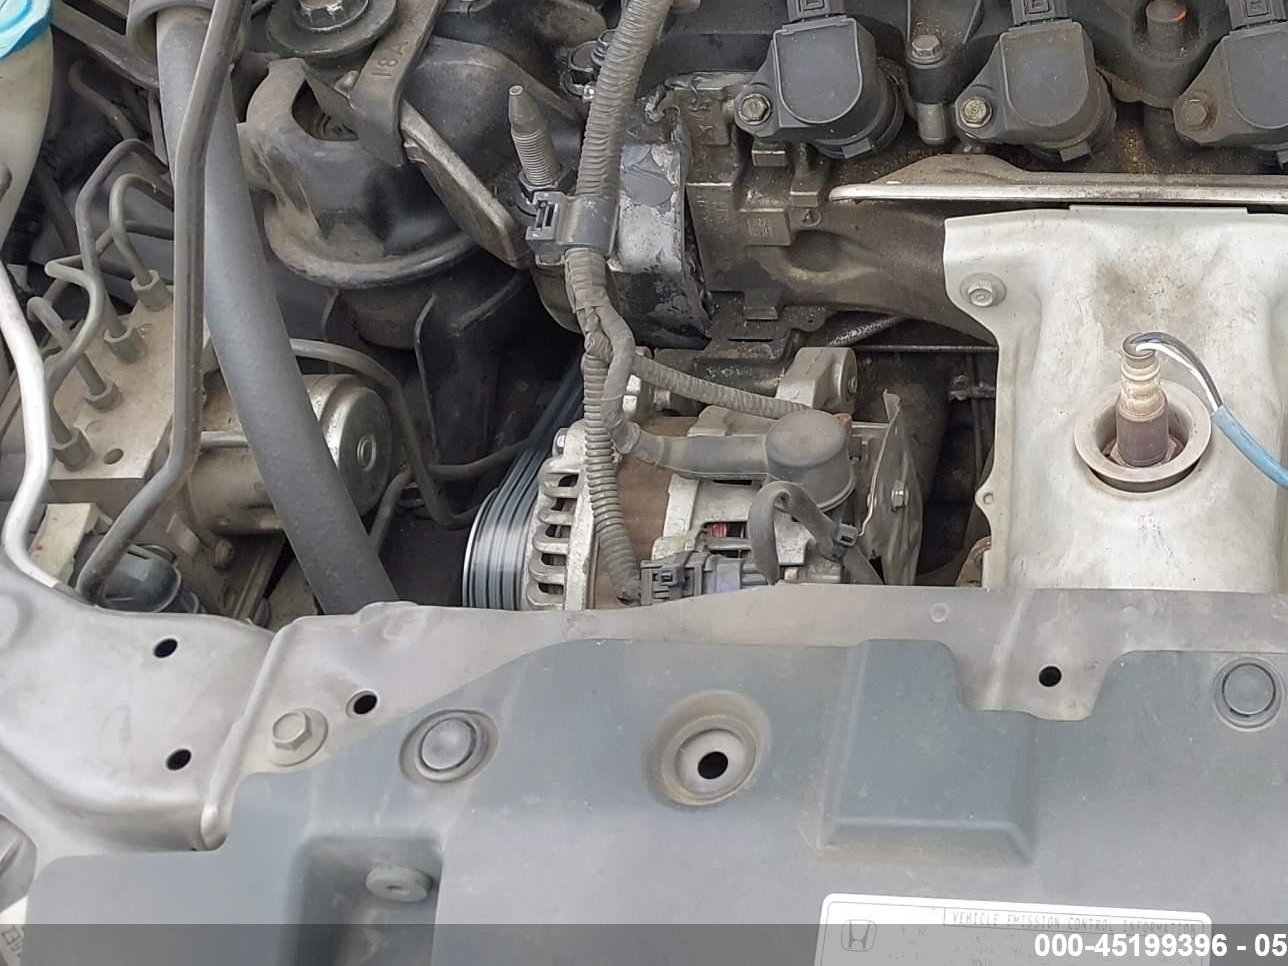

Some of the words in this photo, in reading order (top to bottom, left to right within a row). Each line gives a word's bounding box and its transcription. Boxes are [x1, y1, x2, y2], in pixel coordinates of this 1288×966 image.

[952, 911, 1000, 926] VEHICLE
[1006, 914, 1061, 930] EMISSION
[1067, 916, 1114, 932] CONTROL
